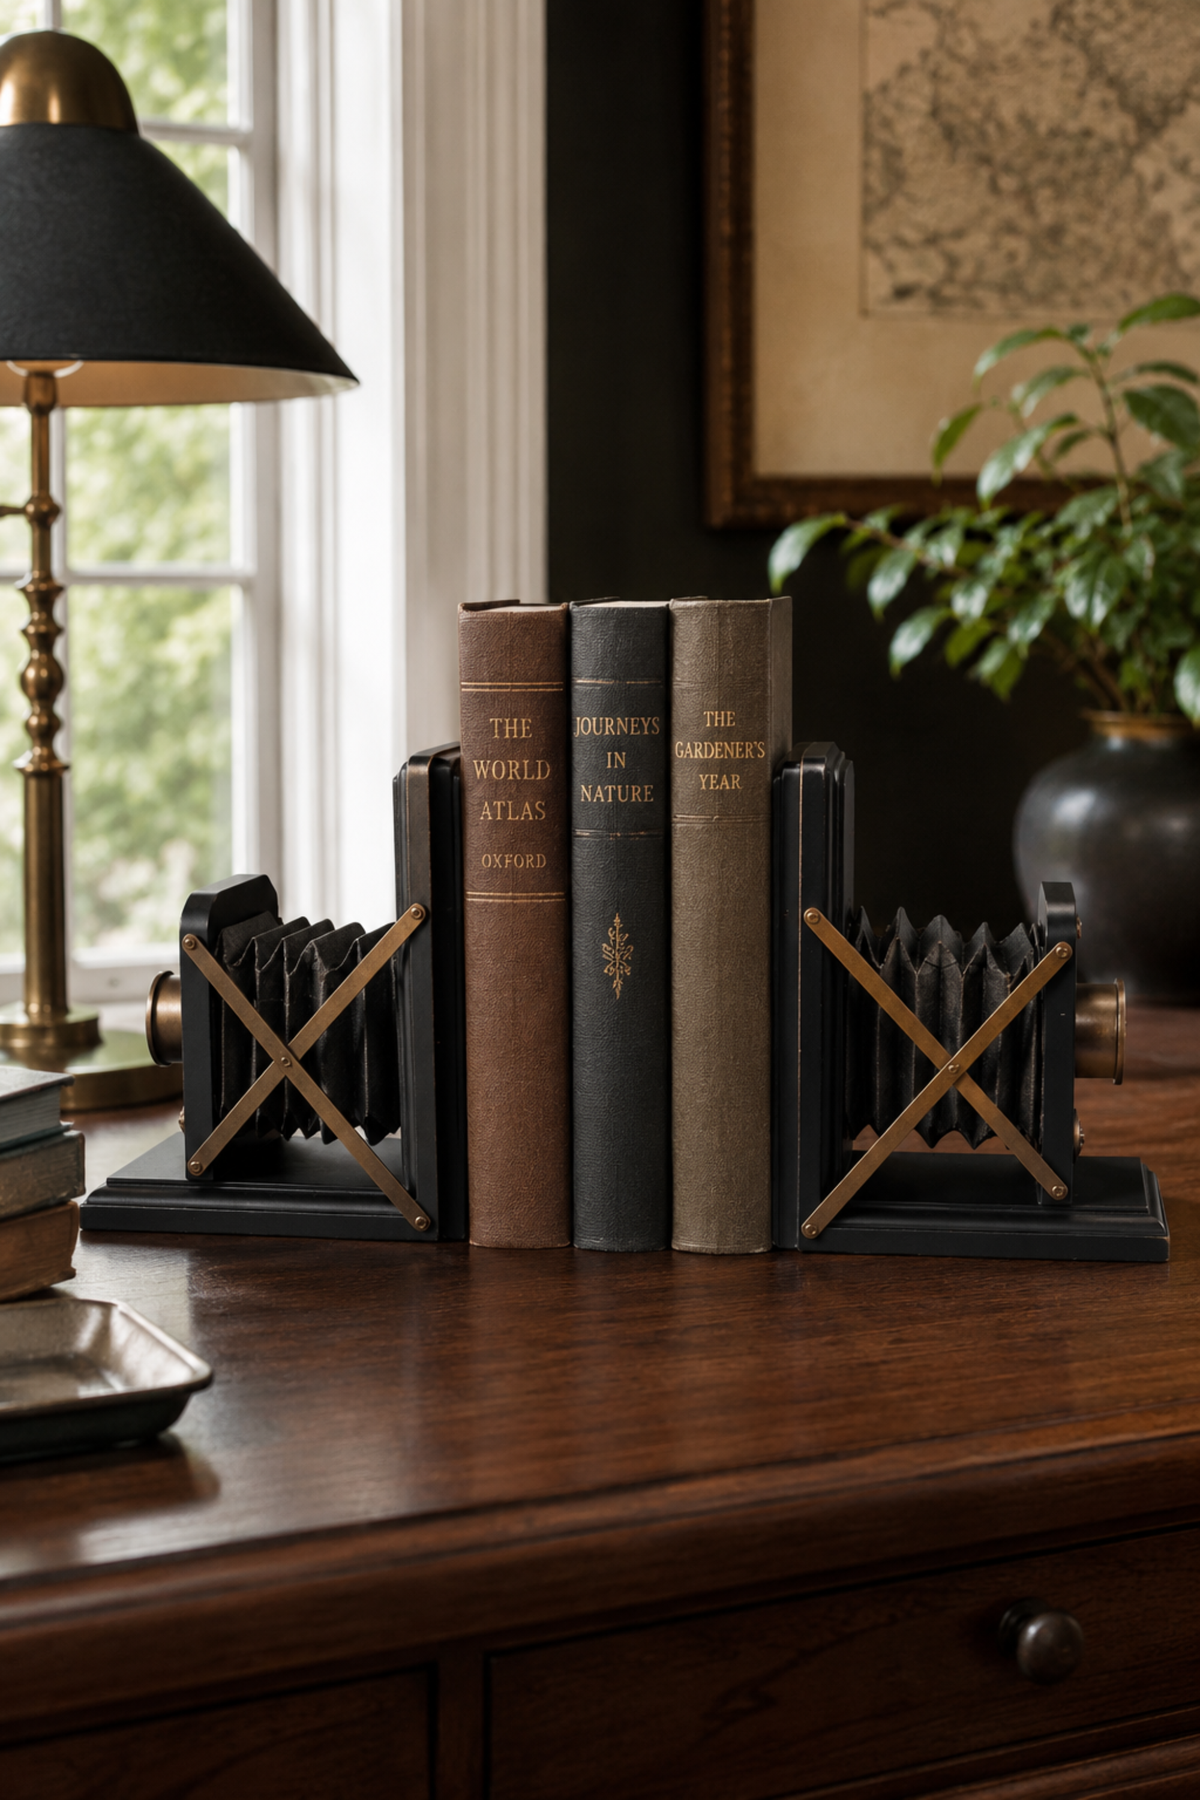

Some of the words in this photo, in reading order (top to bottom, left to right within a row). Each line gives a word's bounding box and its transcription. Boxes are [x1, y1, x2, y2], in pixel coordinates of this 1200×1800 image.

[573, 717, 660, 738] JOURNEYS
[703, 711, 736, 727] THE
[489, 718, 533, 739] THE
[674, 741, 766, 759] GARDENER'S
[606, 752, 626, 768] IN
[473, 759, 551, 781] WORLD
[699, 774, 742, 791] YEAR
[580, 784, 654, 803] NATURE
[479, 800, 546, 821] ATLAS
[481, 853, 547, 869] OXFORD
